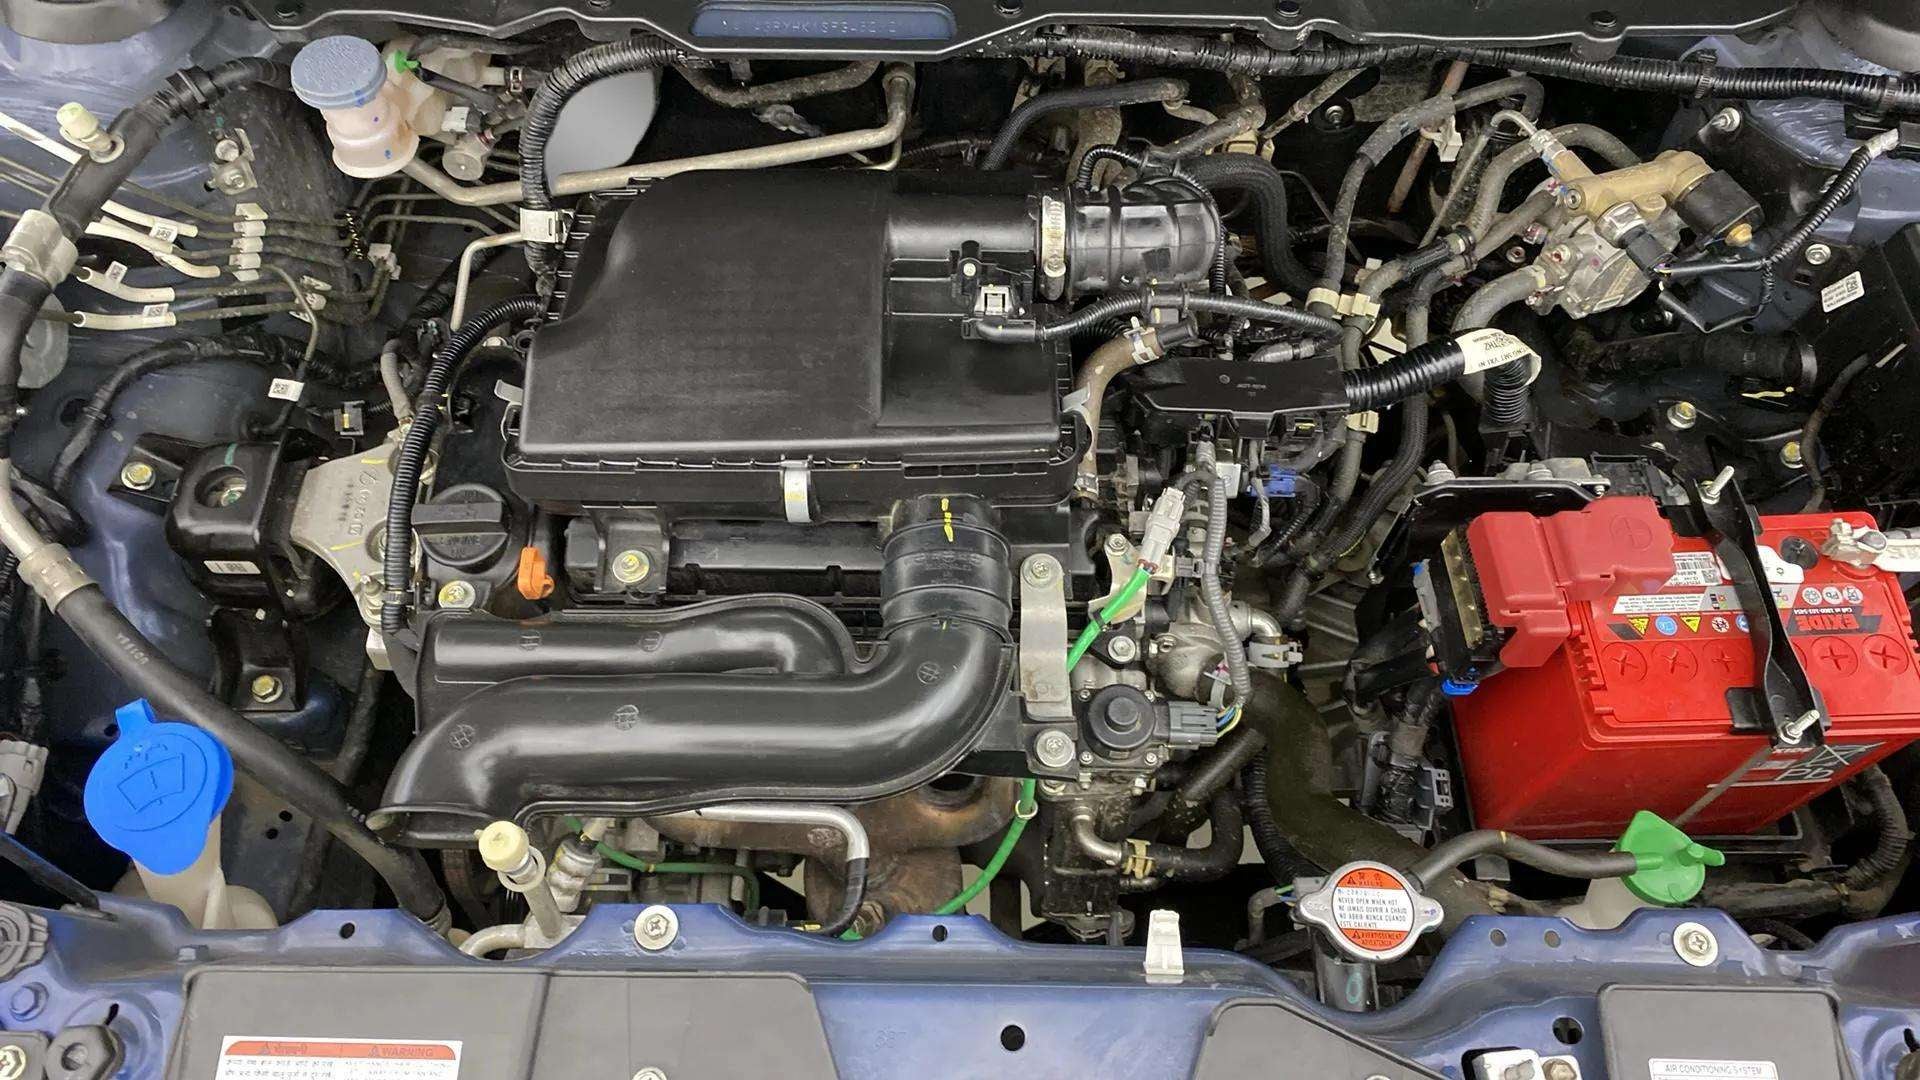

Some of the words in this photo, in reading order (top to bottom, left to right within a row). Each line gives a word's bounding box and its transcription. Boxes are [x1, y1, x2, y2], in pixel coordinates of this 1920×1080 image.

[1795, 614, 1860, 631] EXIDE
[1774, 768, 1835, 782] Pb
[382, 1047, 434, 1057] WARNING
[1665, 1064, 1677, 1073] AIR
[1679, 1064, 1732, 1074] CONDITIONING
